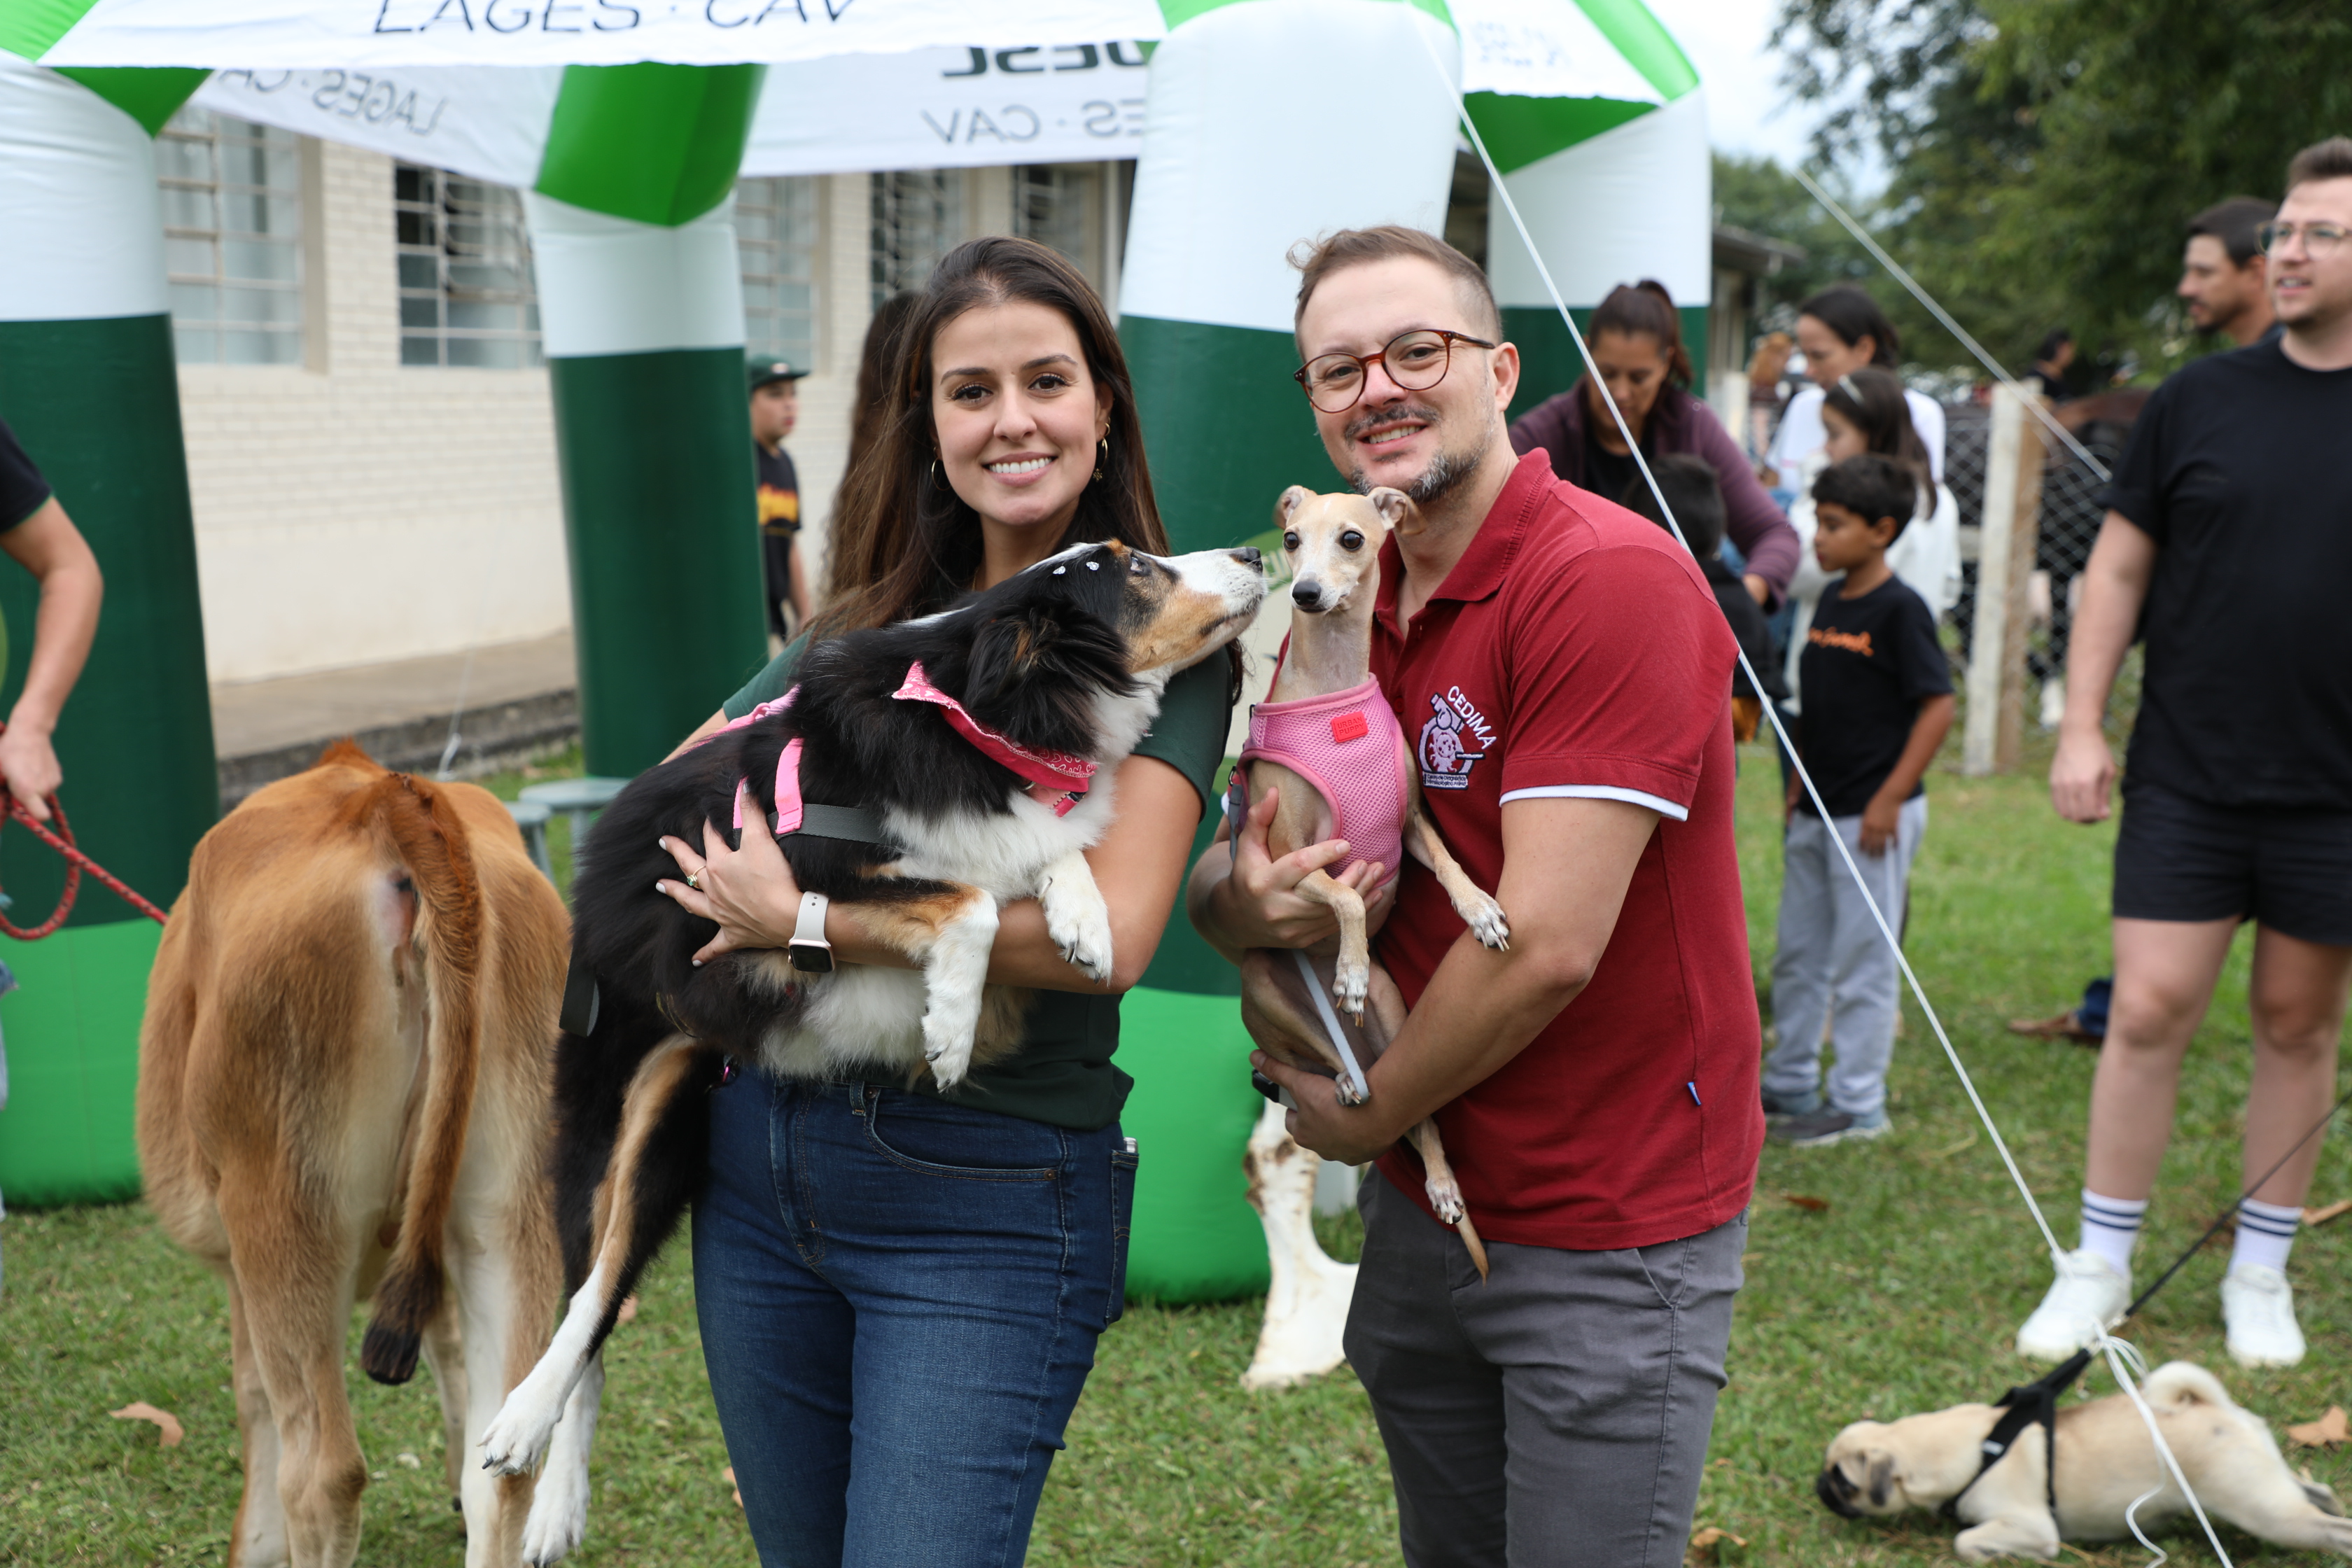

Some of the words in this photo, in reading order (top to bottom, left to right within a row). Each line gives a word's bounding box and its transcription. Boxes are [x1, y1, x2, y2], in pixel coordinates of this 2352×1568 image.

[375, 0, 640, 33] LAGES
[1337, 717, 1363, 729] URBAN
[1447, 685, 1497, 750] CEDIMA
[1339, 723, 1364, 736] PUPPY
